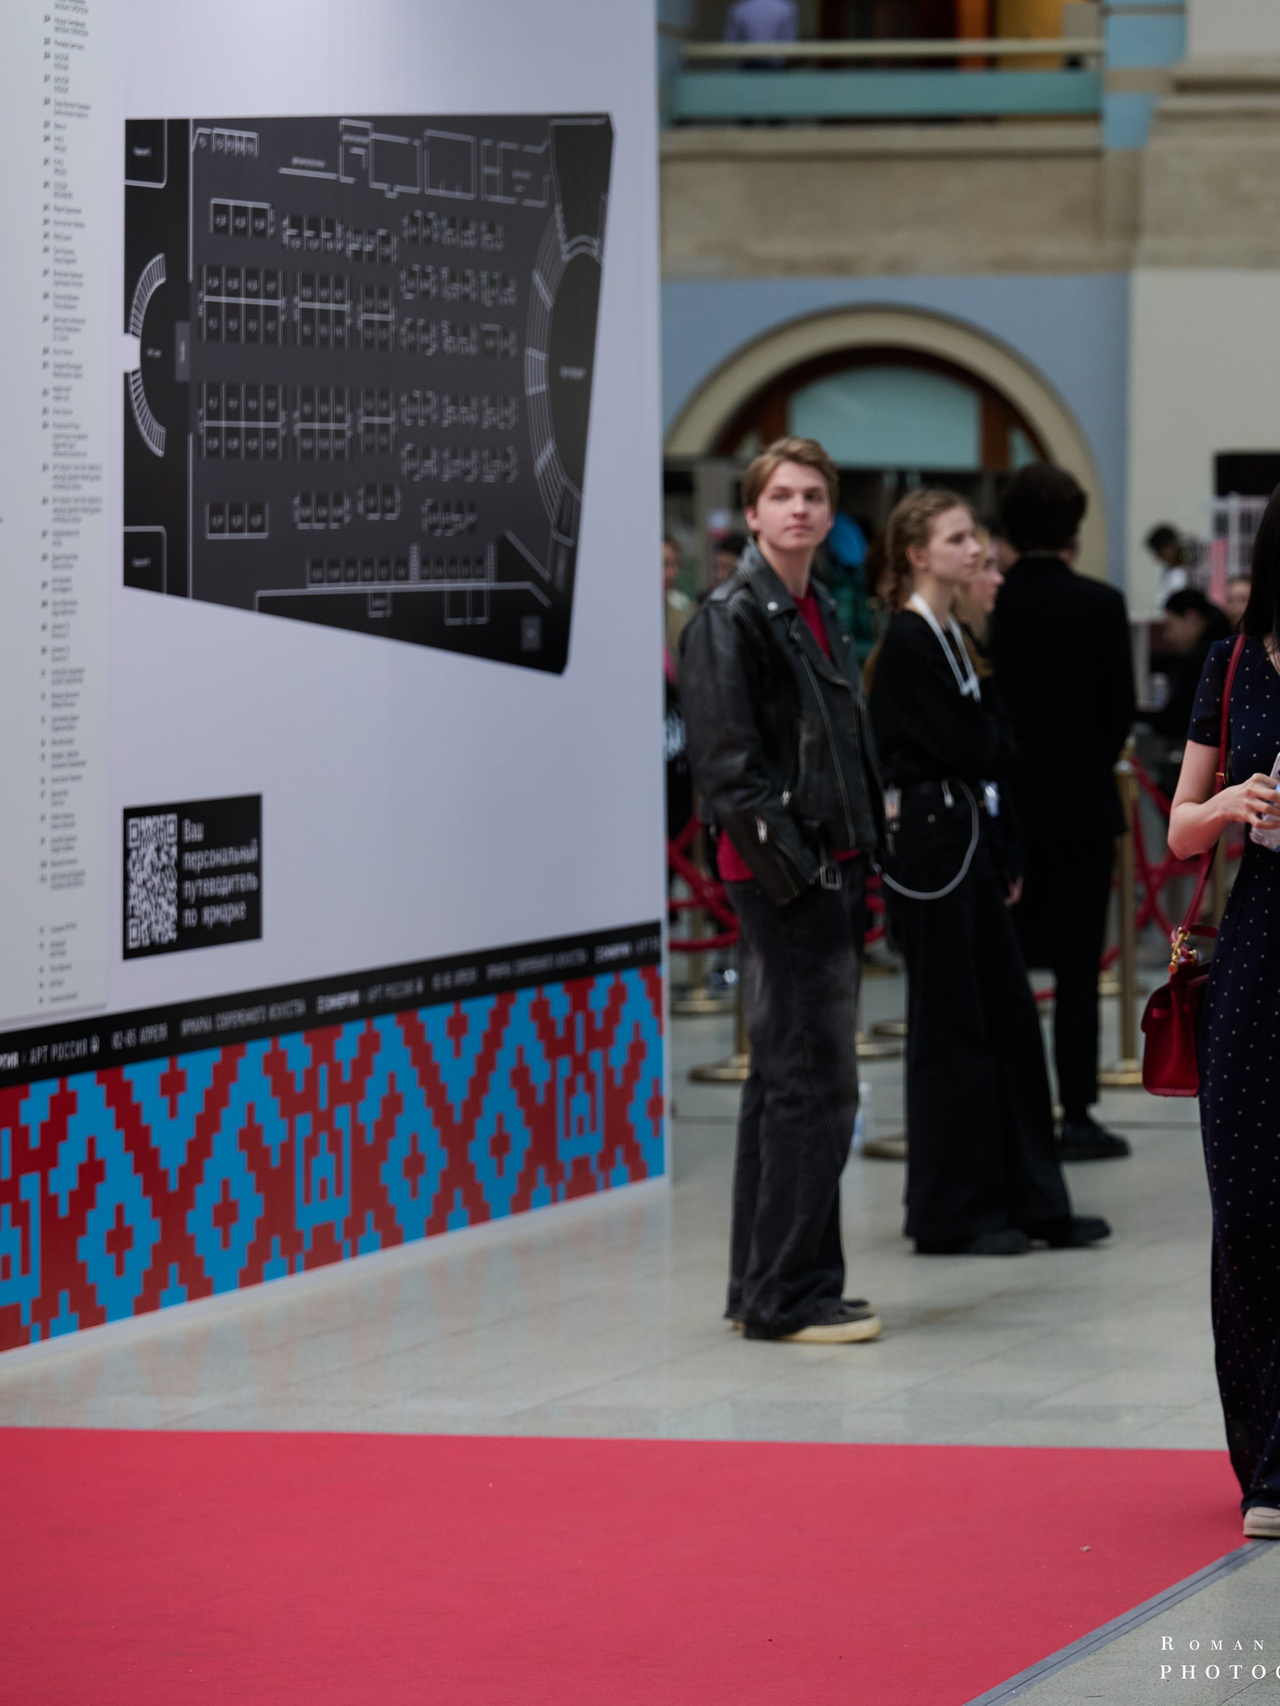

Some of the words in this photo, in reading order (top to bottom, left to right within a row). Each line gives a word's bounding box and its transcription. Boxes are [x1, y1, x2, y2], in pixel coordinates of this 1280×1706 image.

[183, 818, 204, 843] Ваш
[183, 837, 258, 875] персональный
[183, 872, 258, 905] путеводитель
[183, 897, 198, 928] по
[202, 900, 247, 930] ярмарке
[29, 1043, 48, 1066] АРТ
[52, 1037, 88, 1062] РОССИЯ
